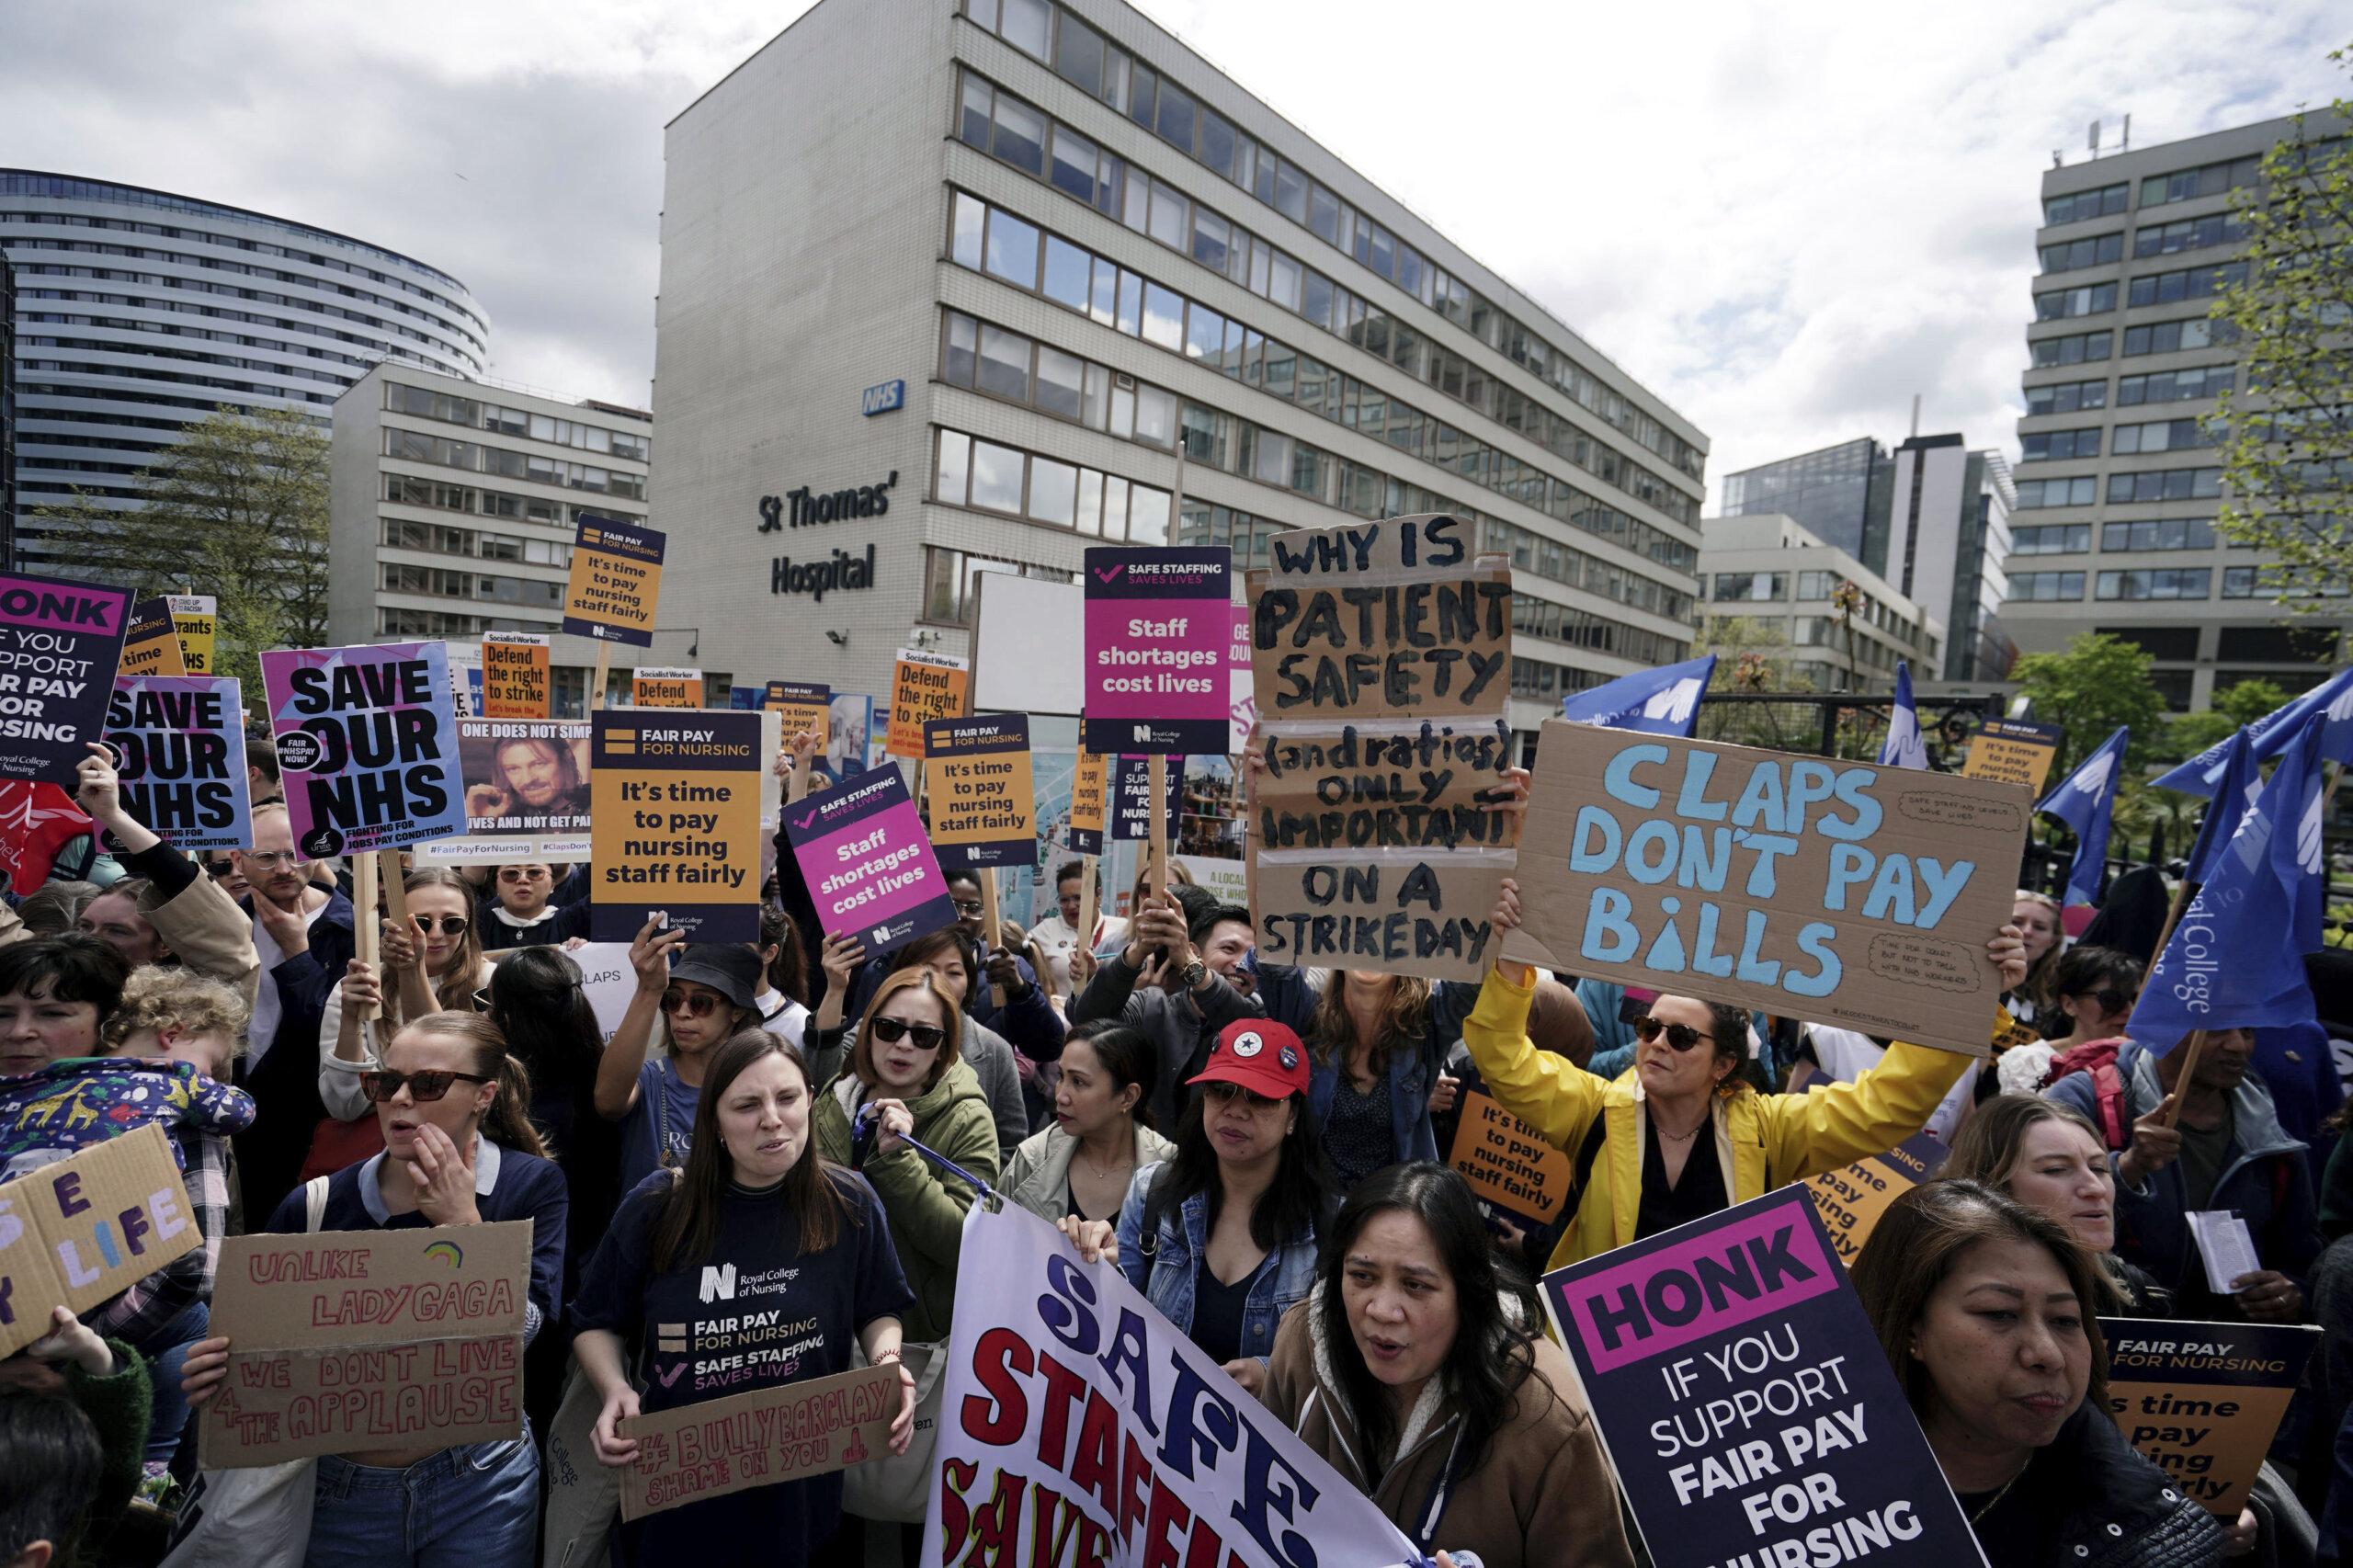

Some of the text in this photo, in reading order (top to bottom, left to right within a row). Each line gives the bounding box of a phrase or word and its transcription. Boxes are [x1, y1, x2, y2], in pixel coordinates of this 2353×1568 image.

[863, 381, 898, 413] NHS
[757, 495, 782, 533] St
[602, 539, 659, 557] FOR NURSING
[603, 531, 642, 546] FAIR PAY
[1275, 517, 1465, 574] WHY IS
[588, 556, 646, 578] It's time
[771, 543, 875, 603] Hospital
[1128, 563, 1222, 574] SAFE STAFFING
[594, 573, 638, 592] to pay
[1128, 574, 1202, 585] SAVES LIVES
[0, 588, 113, 628] ONK
[585, 587, 641, 607] nursing
[574, 598, 648, 622] staff fairly
[1255, 580, 1512, 650] PATIENT
[489, 634, 540, 644] Socialist Worker
[1128, 618, 1188, 638] Staff
[16, 630, 76, 654] YOU
[488, 646, 532, 665] Defend
[1097, 646, 1218, 670] shortages
[27, 676, 87, 699] PAY
[290, 660, 432, 714] SAVE
[488, 665, 543, 687] the right
[1102, 673, 1212, 693] cost lives
[1276, 649, 1505, 709] SAFETY
[489, 685, 501, 699] to
[506, 686, 543, 702] strike
[106, 690, 223, 729] SAVE
[299, 709, 441, 774] OUR
[462, 723, 557, 738] ONE DOES NOT
[642, 730, 714, 743] FAIR PAY
[278, 747, 315, 756] #NHSPAY
[288, 739, 306, 747] FAIR
[642, 743, 750, 756] FOR NURSING
[1985, 743, 2040, 757] It's time
[19, 756, 51, 767] College
[104, 732, 230, 779] OUR
[285, 756, 307, 764] NOW!
[1988, 754, 2029, 768] to pay
[1980, 763, 2030, 778] nursing
[306, 764, 448, 830] NHS
[621, 780, 732, 801] It's time
[1316, 769, 1454, 806] ONLY
[1603, 744, 1882, 842] CLAPS
[119, 782, 234, 829] NHS
[346, 820, 415, 839] FIGHTING FOR
[497, 816, 571, 829] AND NOT GET
[634, 811, 719, 834] to pay
[347, 824, 453, 850] JOBS PAY CONDITIONS
[624, 835, 728, 860] nursing
[430, 845, 529, 855] #FairPayForNursing
[606, 862, 745, 889] staff fairly
[1569, 805, 1976, 930] DON'T PAY
[1302, 862, 1442, 913] ON A
[1922, 959, 1932, 967] TO
[2174, 926, 2219, 1014] College
[1483, 1106, 1510, 1129] It's
[1486, 1129, 1544, 1165] to pay
[1474, 1146, 1546, 1187] nursing
[1458, 1159, 1553, 1211] staff fairly
[56, 1187, 187, 1288] LIFE
[740, 1267, 800, 1286] Royal College
[1586, 1224, 1818, 1352] HONK
[739, 1282, 786, 1297] of Nursing
[694, 1310, 780, 1335] FAIR PAY
[695, 1317, 817, 1351] FOR NURSING
[695, 1333, 824, 1375] SAFE STAFFING
[2117, 1340, 2235, 1356] FAIR PAY
[241, 1337, 517, 1389] WE DON'T LIVE
[695, 1358, 800, 1391] SAVES LIVES
[1661, 1324, 1801, 1403] IF YOU
[2113, 1354, 2286, 1373] FOR NURSING
[213, 1376, 517, 1445] 4 THE APPLAUSE
[1038, 1253, 1321, 1568] SAFE
[1650, 1356, 1850, 1458] SUPPORT
[2142, 1393, 2241, 1417] time
[2131, 1426, 2211, 1448] pay
[1668, 1403, 1870, 1506] FAIR PAY
[645, 1437, 828, 1506] SHAME ON YOU
[1742, 1471, 1847, 1537] FOR
